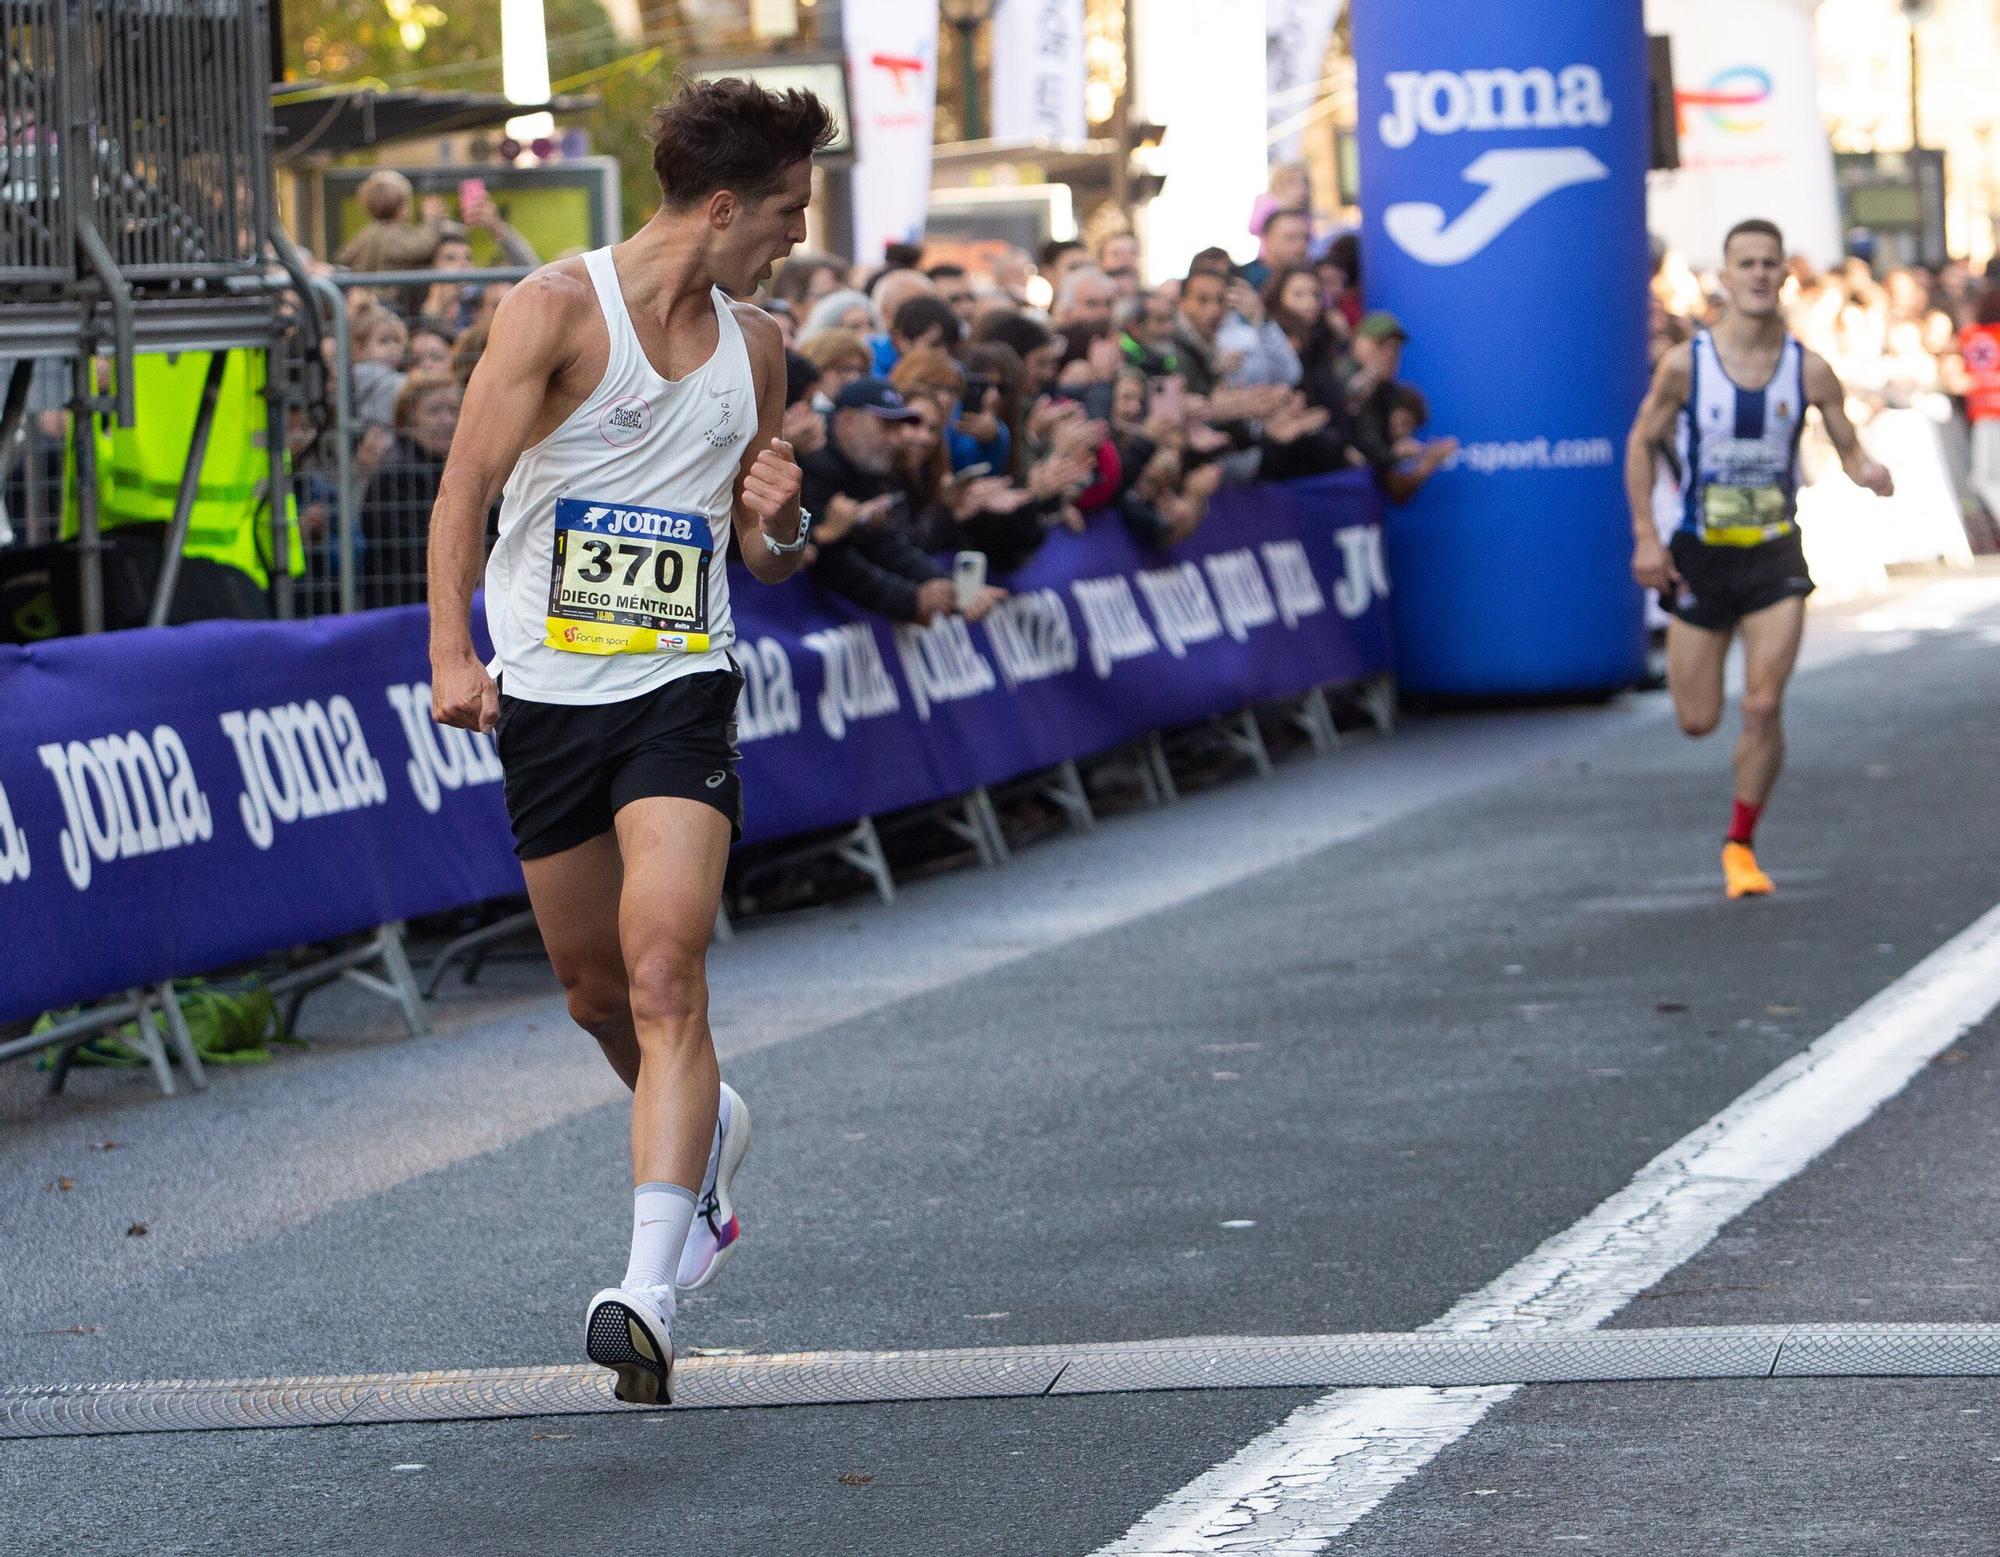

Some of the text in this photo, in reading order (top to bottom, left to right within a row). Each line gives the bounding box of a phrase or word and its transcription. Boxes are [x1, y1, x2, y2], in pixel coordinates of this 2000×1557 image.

[607, 509, 693, 540] Joma
[558, 535, 564, 555] 1
[577, 540, 683, 593] 370
[561, 589, 611, 606] DIEGO
[616, 593, 694, 618] MÉNTRIDA
[605, 636, 629, 646] sport
[219, 695, 387, 850] Joma
[37, 724, 213, 891] Joma
